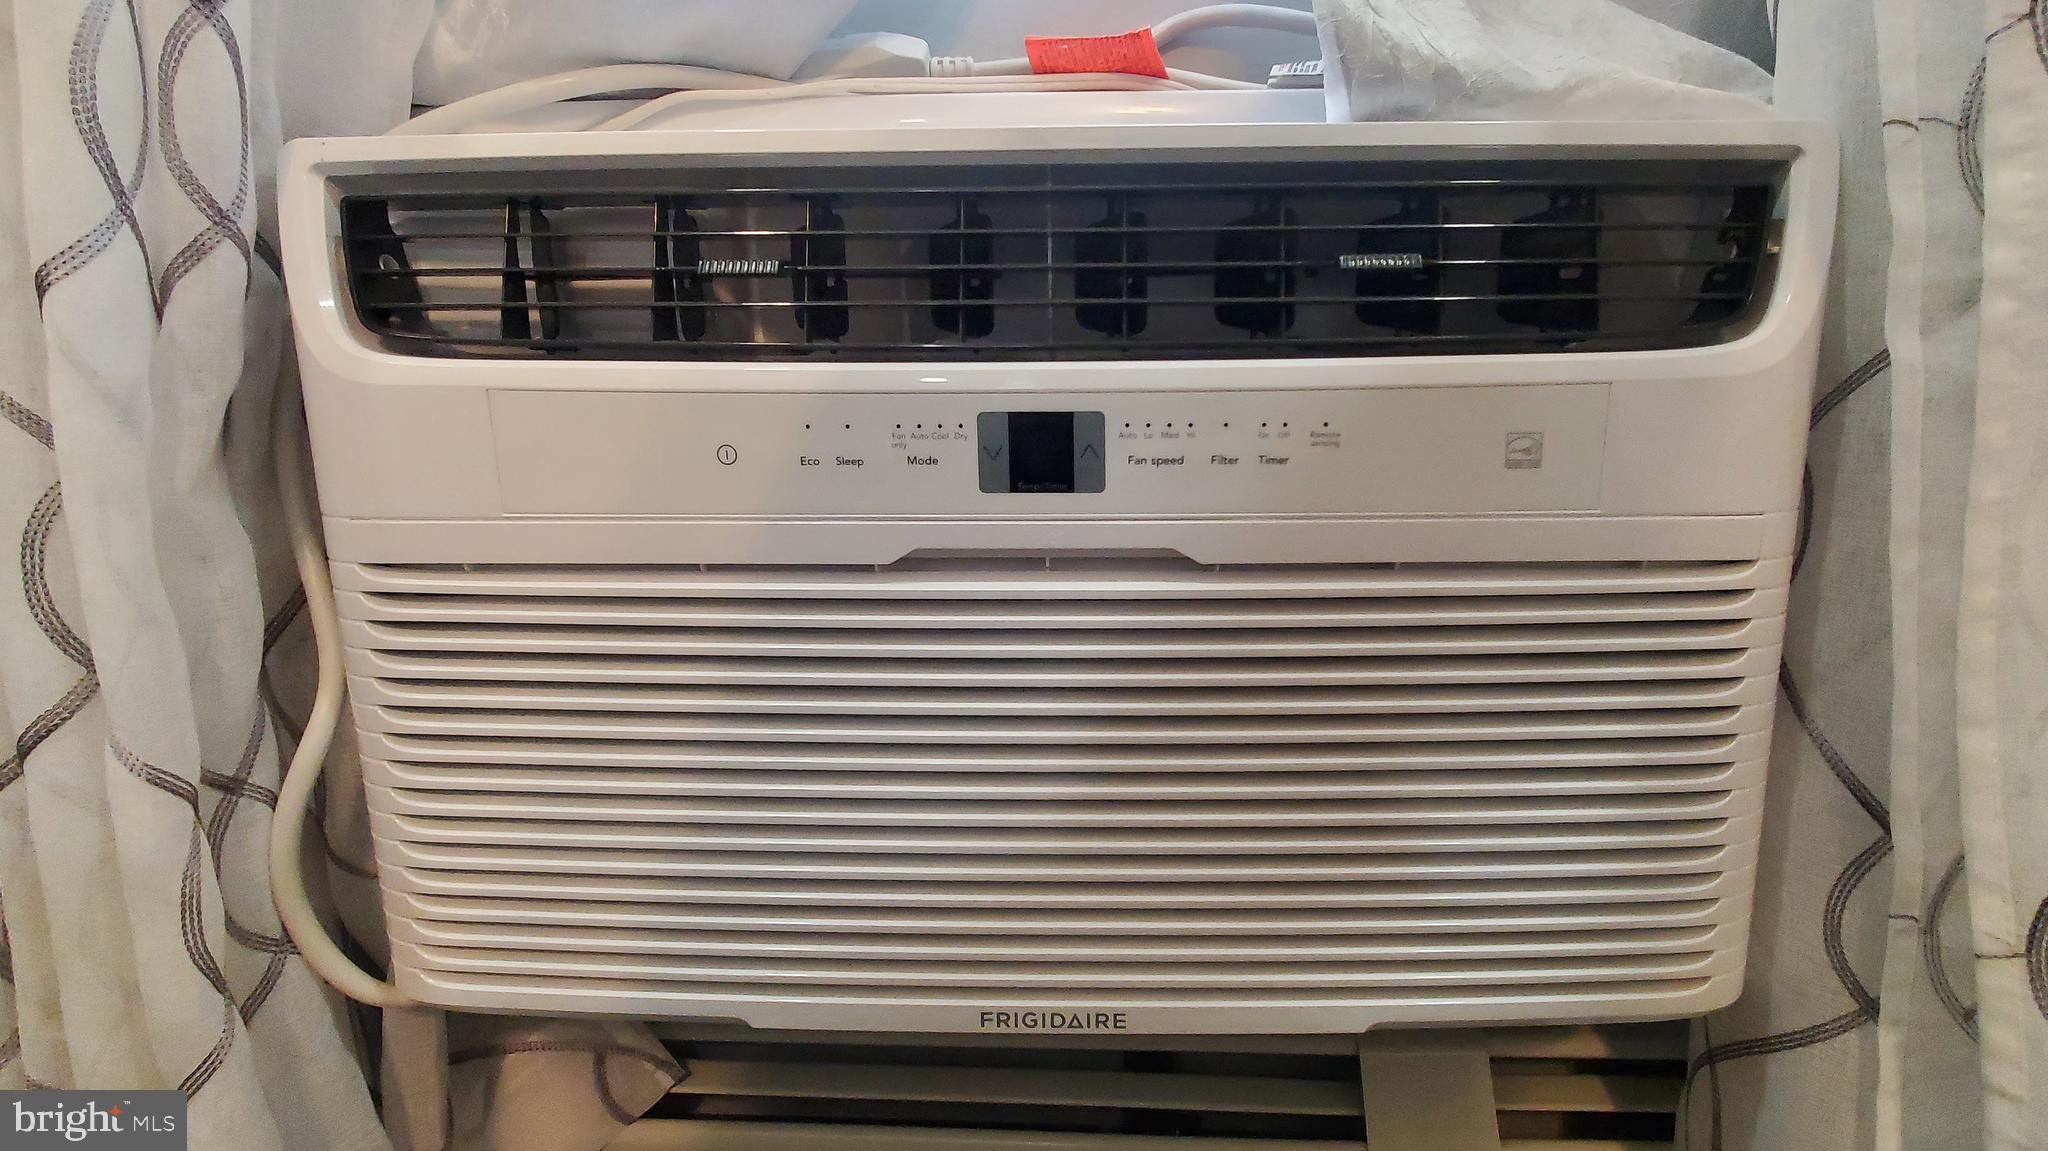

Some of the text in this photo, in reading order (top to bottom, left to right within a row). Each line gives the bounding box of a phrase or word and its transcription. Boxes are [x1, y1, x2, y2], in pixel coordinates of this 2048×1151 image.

[891, 432, 906, 440] Fan
[910, 432, 929, 440] Auto
[931, 432, 950, 440] Cool
[953, 432, 968, 441] Dry
[891, 441, 908, 450] only
[800, 456, 820, 467] Eco
[835, 456, 865, 469] Sleep
[907, 455, 939, 466] Mode
[1127, 455, 1185, 468] Fan speed
[1210, 455, 1240, 466] Filter
[1258, 455, 1290, 465] Timer
[980, 1012, 1127, 1029] FRIGIDAIRE
